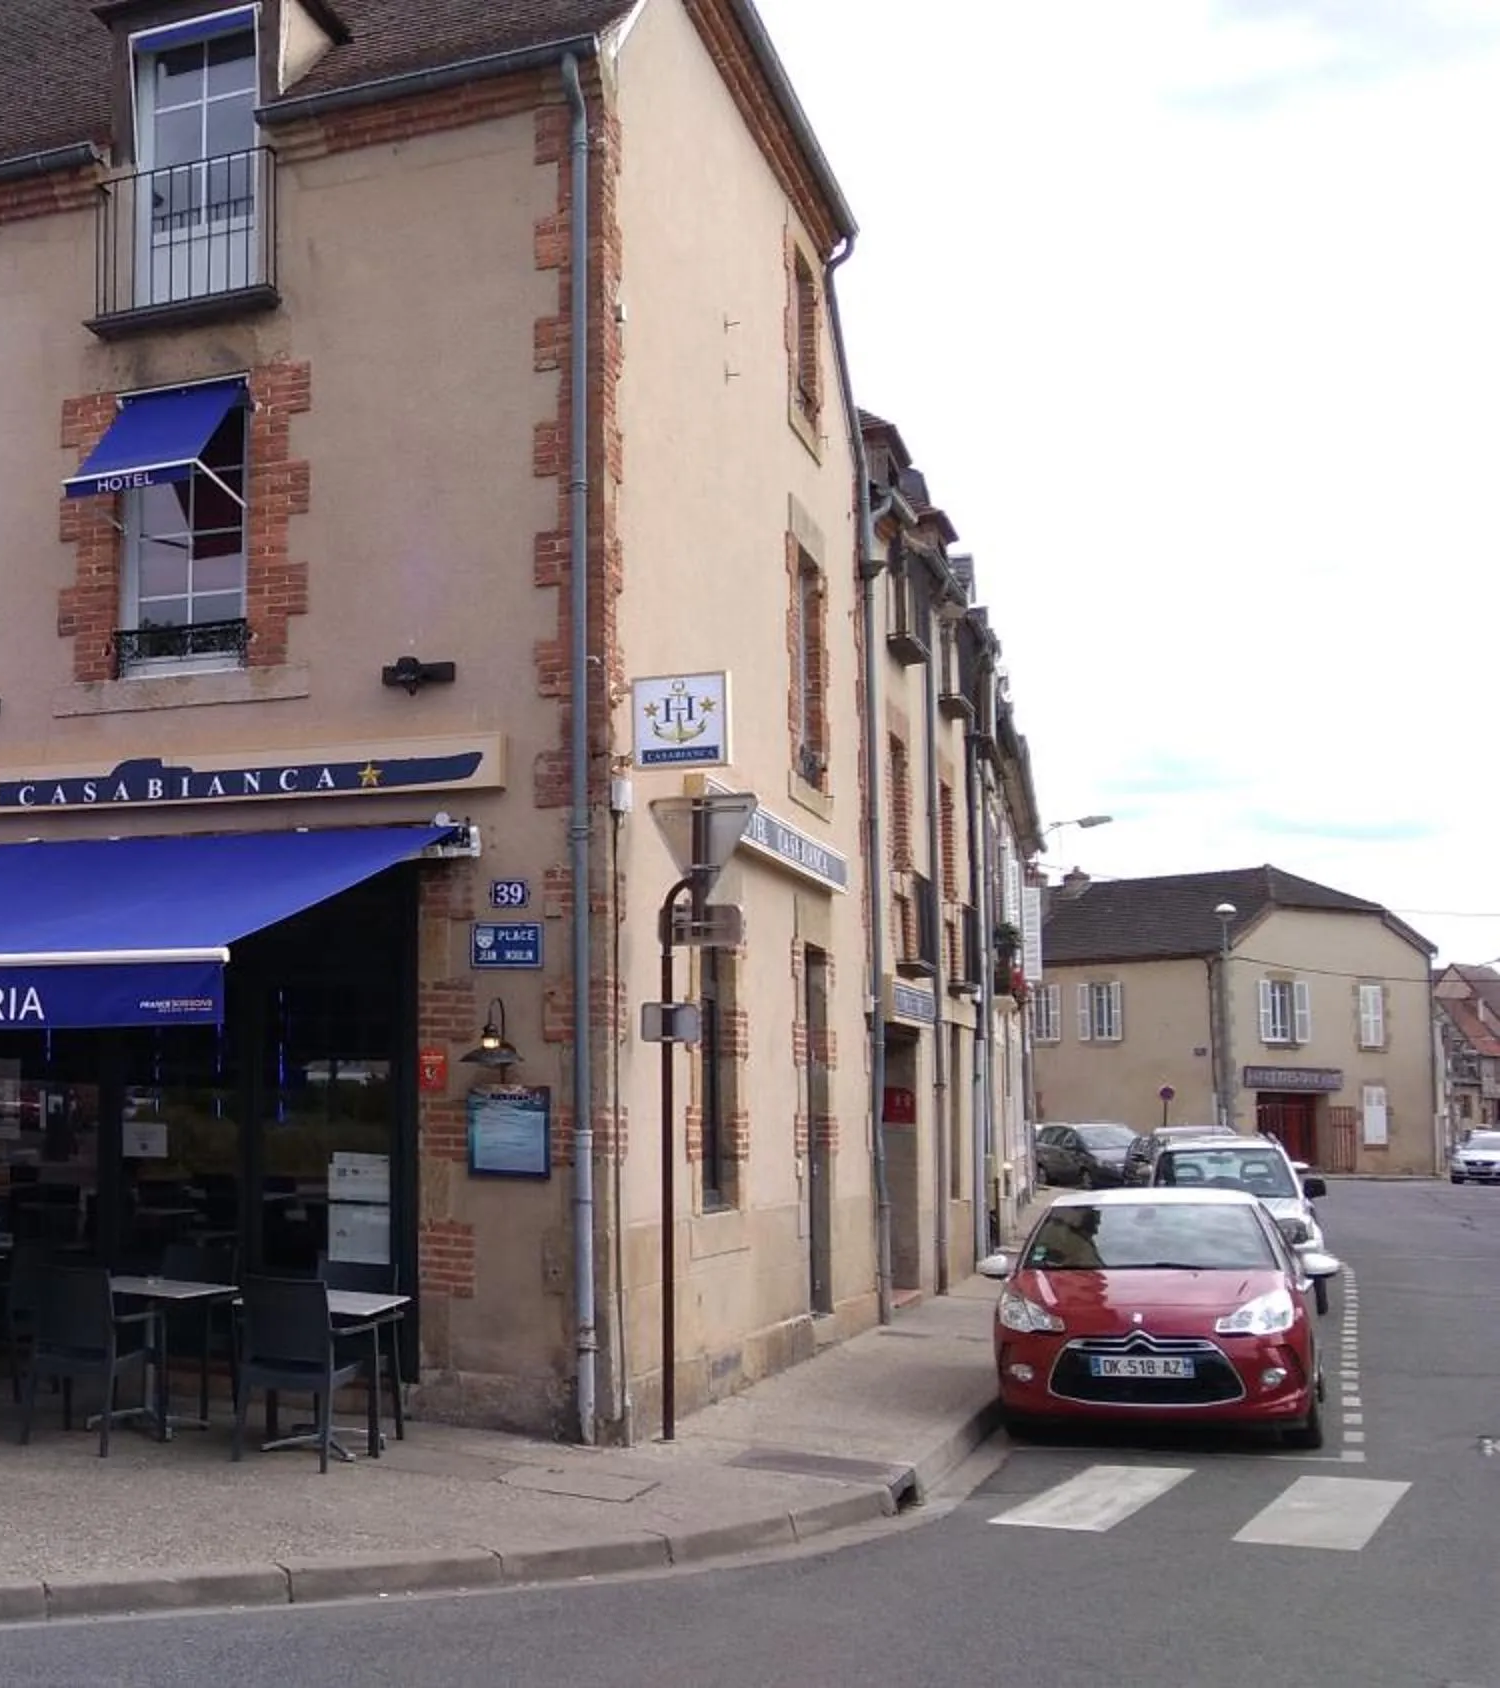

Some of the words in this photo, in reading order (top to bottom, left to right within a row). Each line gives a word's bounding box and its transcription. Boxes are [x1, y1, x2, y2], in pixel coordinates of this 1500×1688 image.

[97, 471, 154, 493] HOTEL
[646, 749, 716, 761] CASABIANCA
[19, 768, 335, 807] CASABIANCA
[495, 883, 523, 905] 39
[497, 929, 536, 941] PLACE
